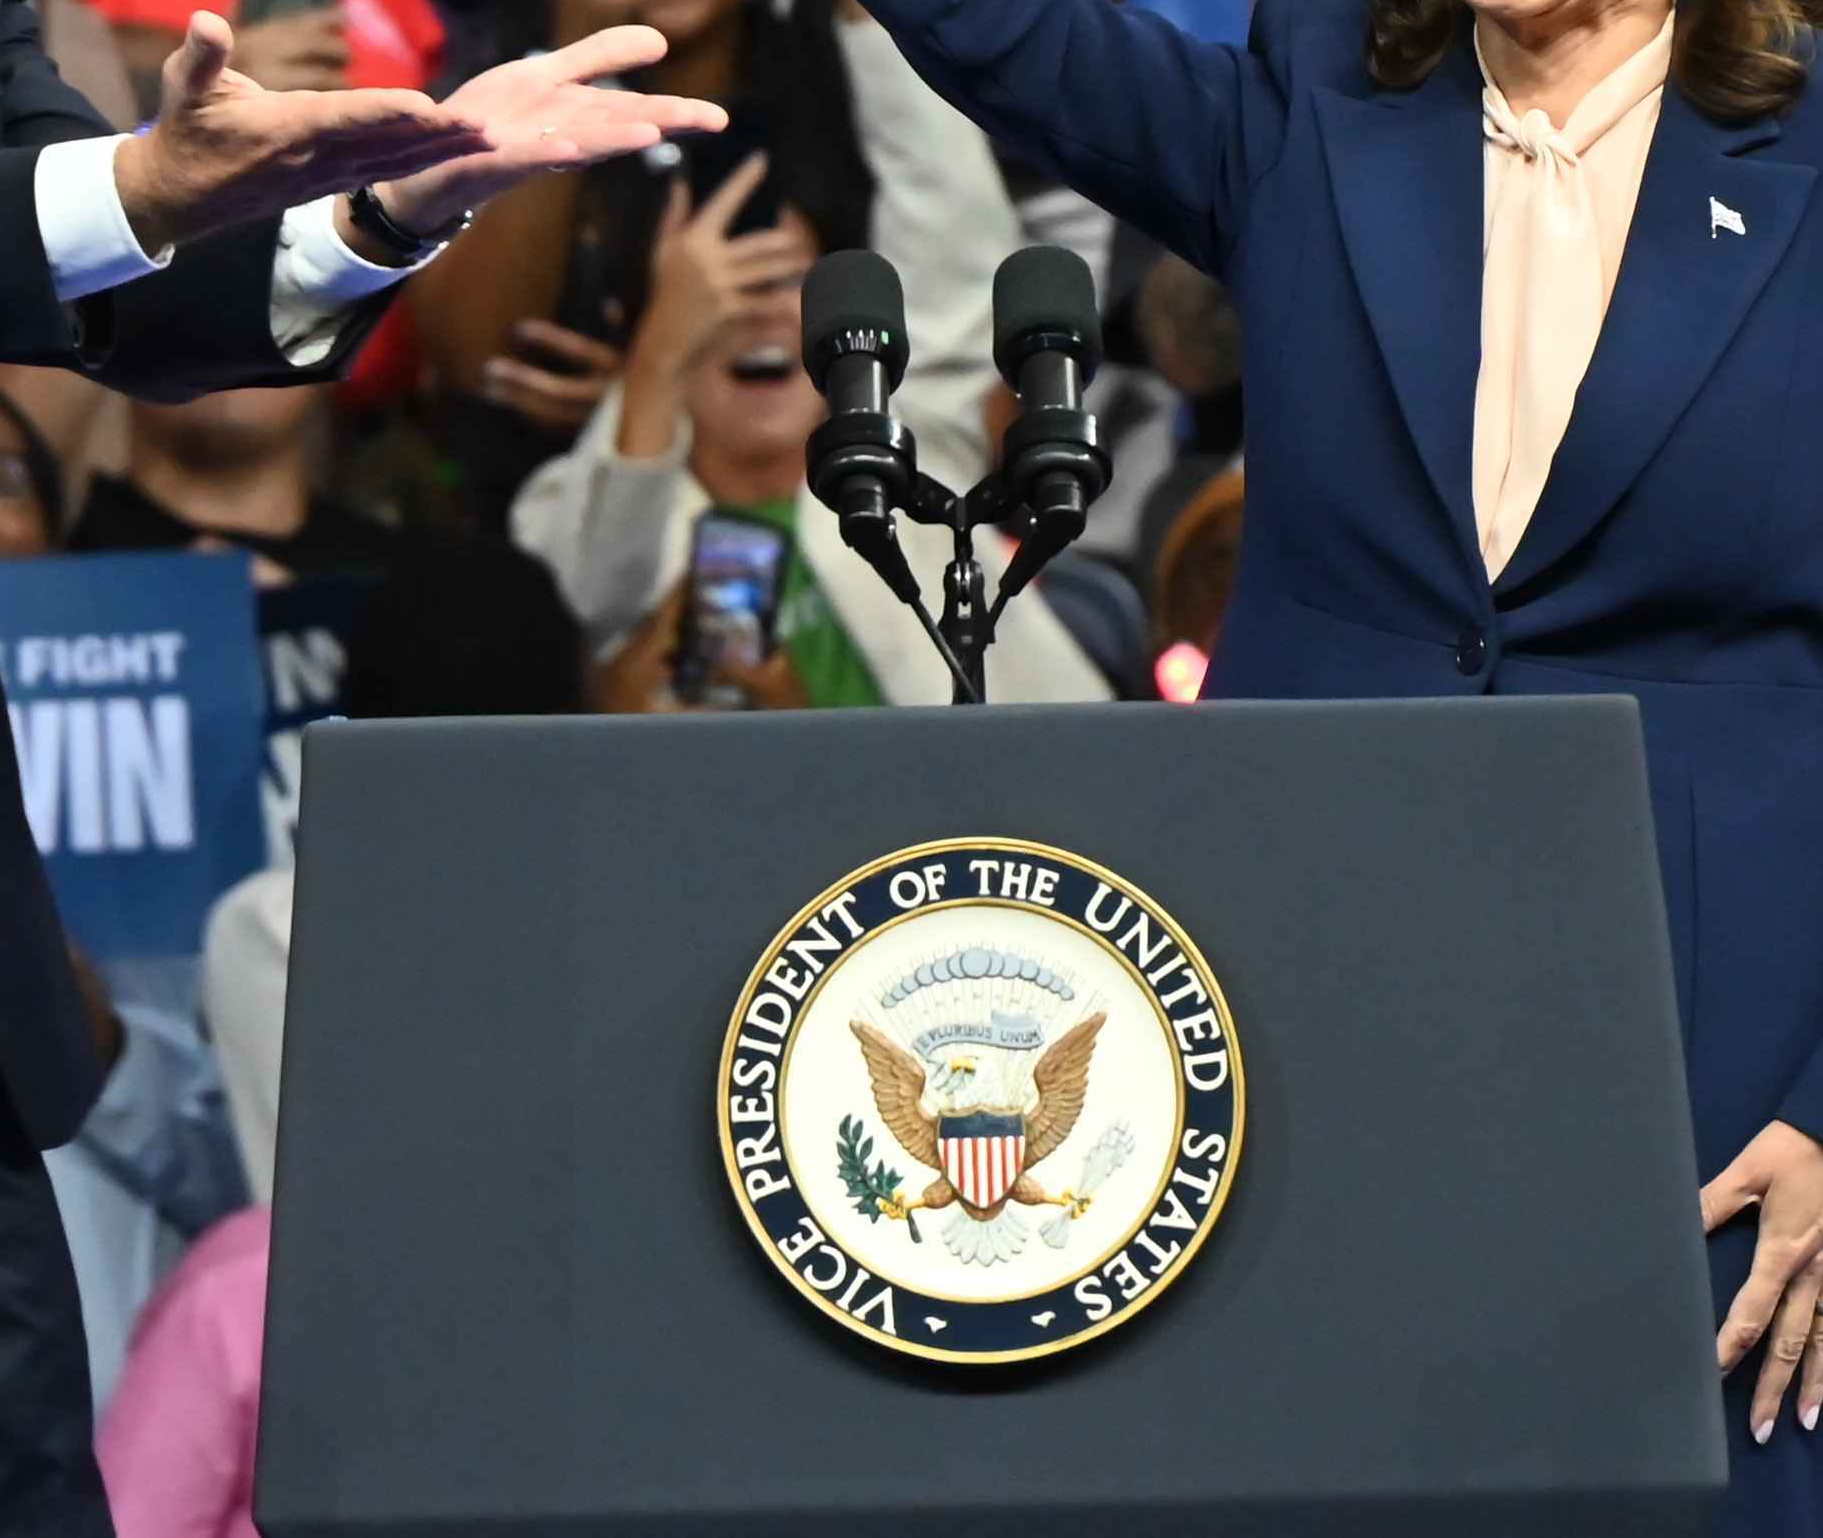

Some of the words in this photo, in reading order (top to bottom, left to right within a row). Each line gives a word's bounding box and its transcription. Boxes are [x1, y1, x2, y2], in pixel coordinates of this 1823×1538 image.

[17, 631, 183, 687] FIGHT
[888, 862, 948, 910] OF
[968, 859, 1061, 908] THE
[1083, 882, 1228, 1092] UNITED
[730, 892, 866, 1200] PRESIDENT
[999, 1027, 1042, 1044] UNUM
[1073, 1127, 1227, 1323] STATES
[778, 1218, 897, 1337] VICE
